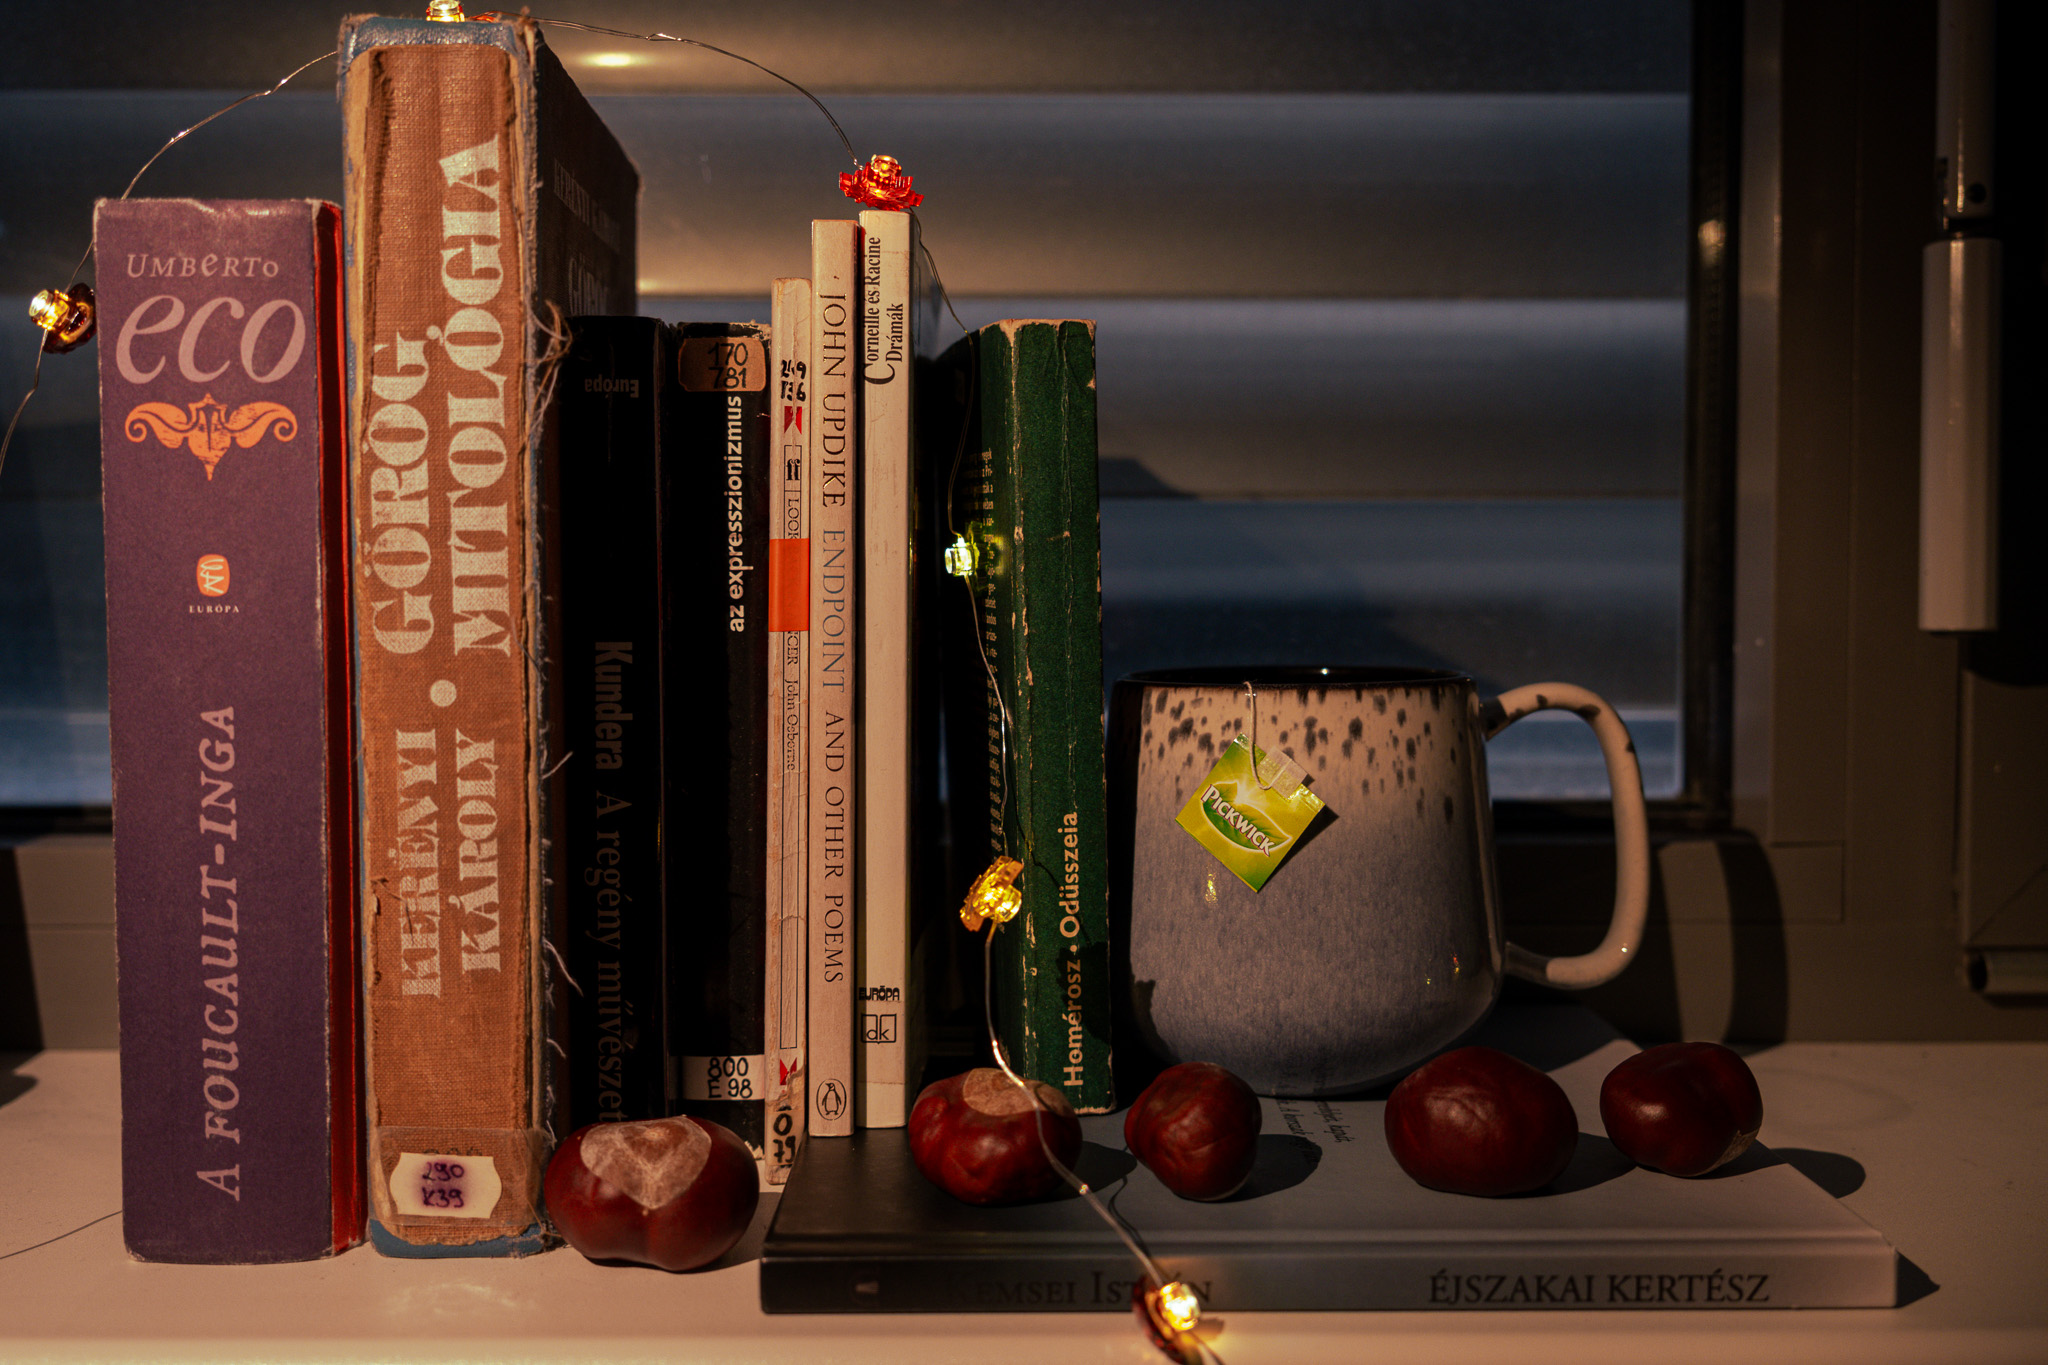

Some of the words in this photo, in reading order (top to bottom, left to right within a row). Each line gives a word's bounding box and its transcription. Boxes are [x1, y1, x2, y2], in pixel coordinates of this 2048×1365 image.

[863, 237, 881, 287] Racine
[864, 290, 880, 304] és
[708, 340, 748, 367] 170
[821, 293, 847, 379] JOHN
[862, 307, 896, 386] Corneille
[884, 302, 904, 363] Drámák
[424, 134, 512, 656] MITOLÓGIA
[711, 366, 748, 388] 781
[822, 390, 847, 508] UPDIKE
[366, 331, 436, 655] GÖRÖG
[722, 395, 755, 600] expresszionizmus
[188, 603, 241, 614] EURÓPA
[728, 605, 745, 633] az
[821, 528, 846, 693] ENDPOINT
[594, 639, 635, 771] Kundera
[785, 679, 799, 711] John
[824, 711, 846, 774] AND
[595, 788, 633, 821] A
[823, 785, 846, 881] OTHER
[1200, 783, 1276, 858] PICKWICK
[389, 728, 442, 998] KERÉNYI
[448, 728, 503, 975] KÁROLY
[1057, 811, 1081, 939] Odüsszeia
[197, 705, 242, 1143] FOUCAULT-INGA
[583, 829, 634, 951] regény
[824, 893, 846, 984] POEMS
[1061, 959, 1085, 1087] Homérosz
[707, 1057, 749, 1079] 800
[707, 1077, 722, 1099] E
[727, 1078, 753, 1099] 98
[197, 1163, 242, 1201] A
[421, 1185, 464, 1208] K39
[1091, 1271, 1213, 1303] ISTN
[1428, 1268, 1594, 1306] ÉJSZAKAI
[1606, 1267, 1770, 1303] KERTÉSZ
